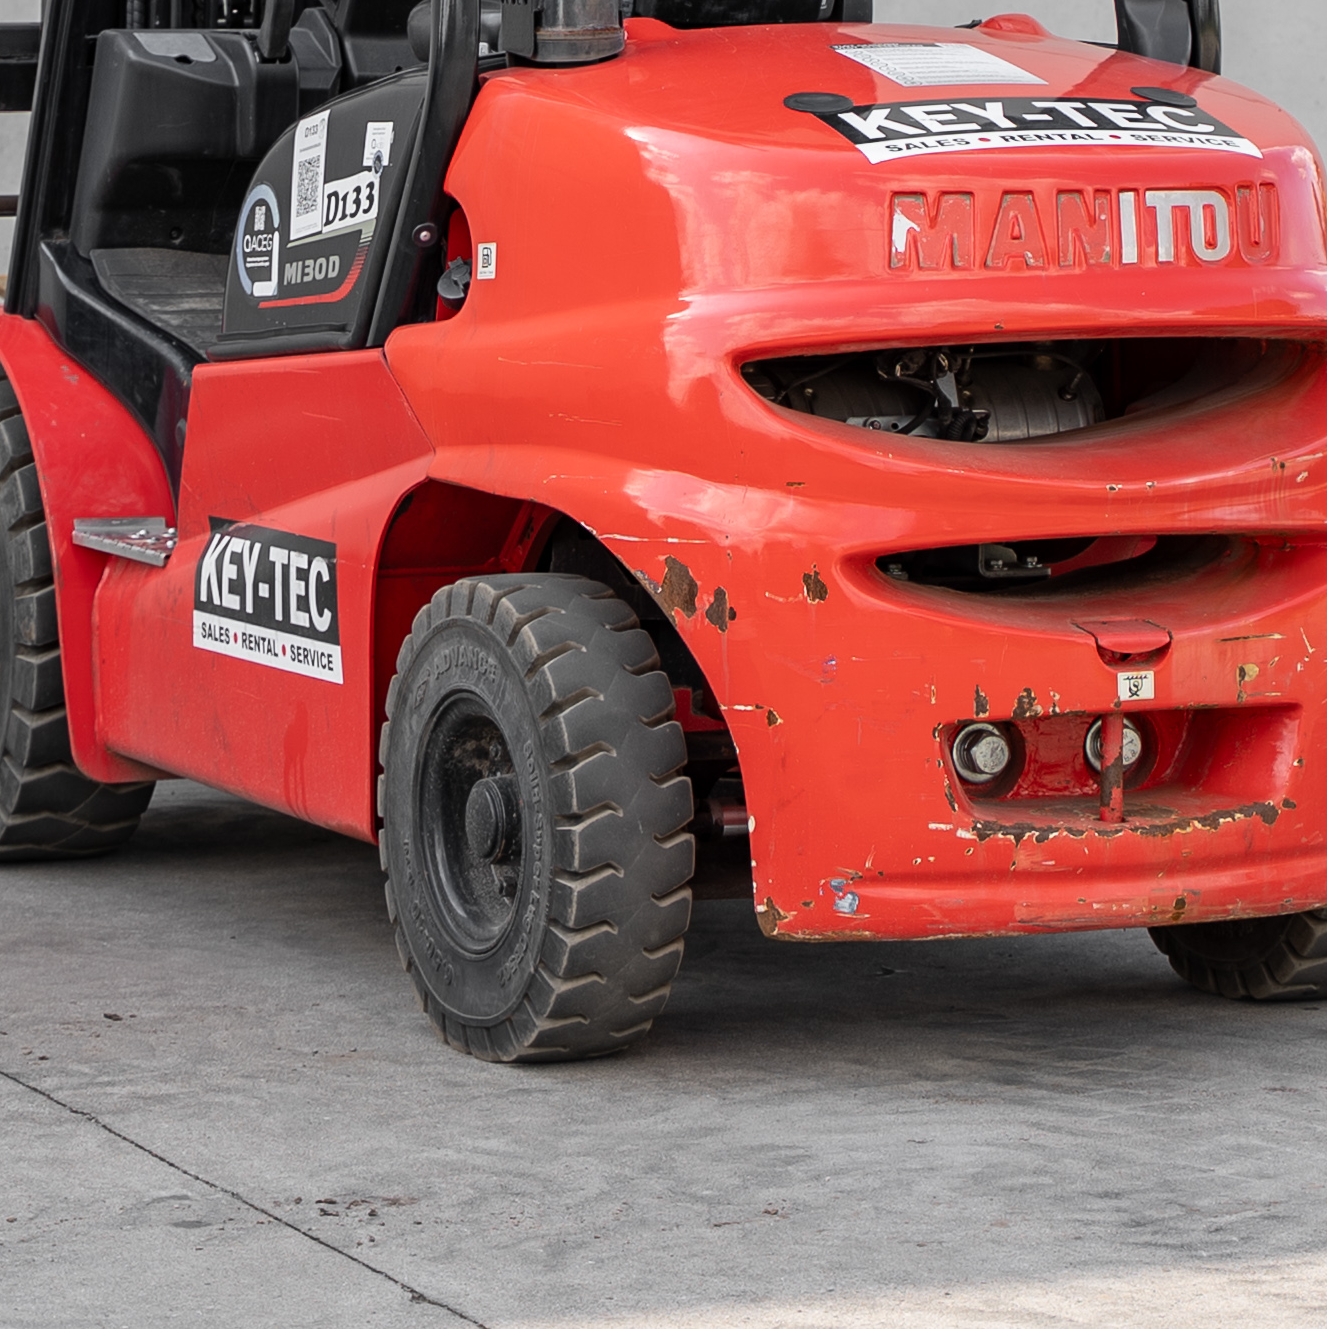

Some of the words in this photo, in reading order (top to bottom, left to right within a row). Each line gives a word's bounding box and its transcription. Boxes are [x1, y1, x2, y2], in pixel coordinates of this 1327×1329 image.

[838, 100, 1216, 139] KEY-TEC
[885, 137, 970, 152] SALES
[1000, 132, 1105, 143] RENTAL
[1131, 134, 1241, 148] SERVICE
[323, 180, 375, 227] D133
[888, 182, 1280, 269] MANITOU
[200, 533, 332, 632] KEY-TEC
[201, 622, 230, 644] SALES
[241, 632, 278, 657] RENTAL
[290, 644, 334, 671] SERVICE
[434, 645, 498, 684] ADVANCE
